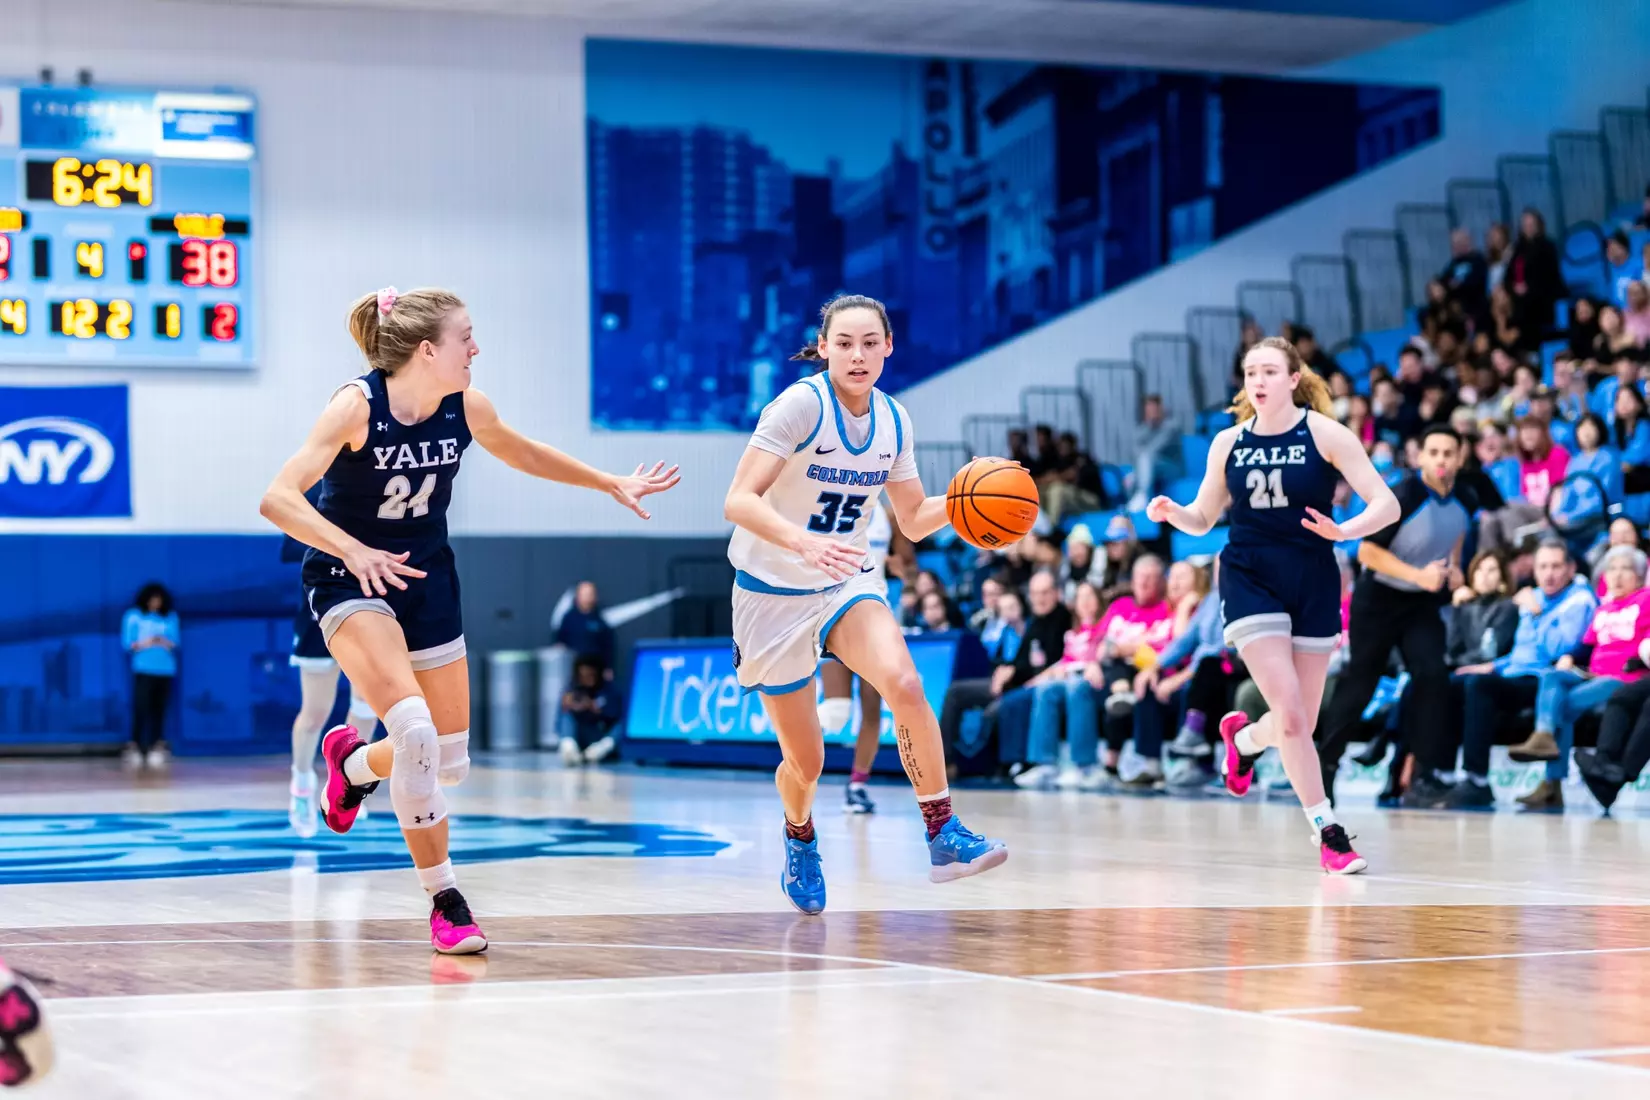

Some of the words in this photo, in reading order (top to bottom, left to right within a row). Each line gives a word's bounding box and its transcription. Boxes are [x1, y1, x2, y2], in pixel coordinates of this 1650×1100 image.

[53, 157, 153, 208] 6:24
[76, 242, 104, 278] 4
[182, 239, 239, 288] 38
[166, 303, 181, 338] 1
[212, 302, 238, 341] 2
[373, 438, 459, 470] YALE
[1233, 444, 1307, 468] YALE
[806, 463, 889, 487] COLUMBIA
[1246, 468, 1290, 510] 21
[377, 473, 437, 520] 24
[805, 490, 870, 535] 35
